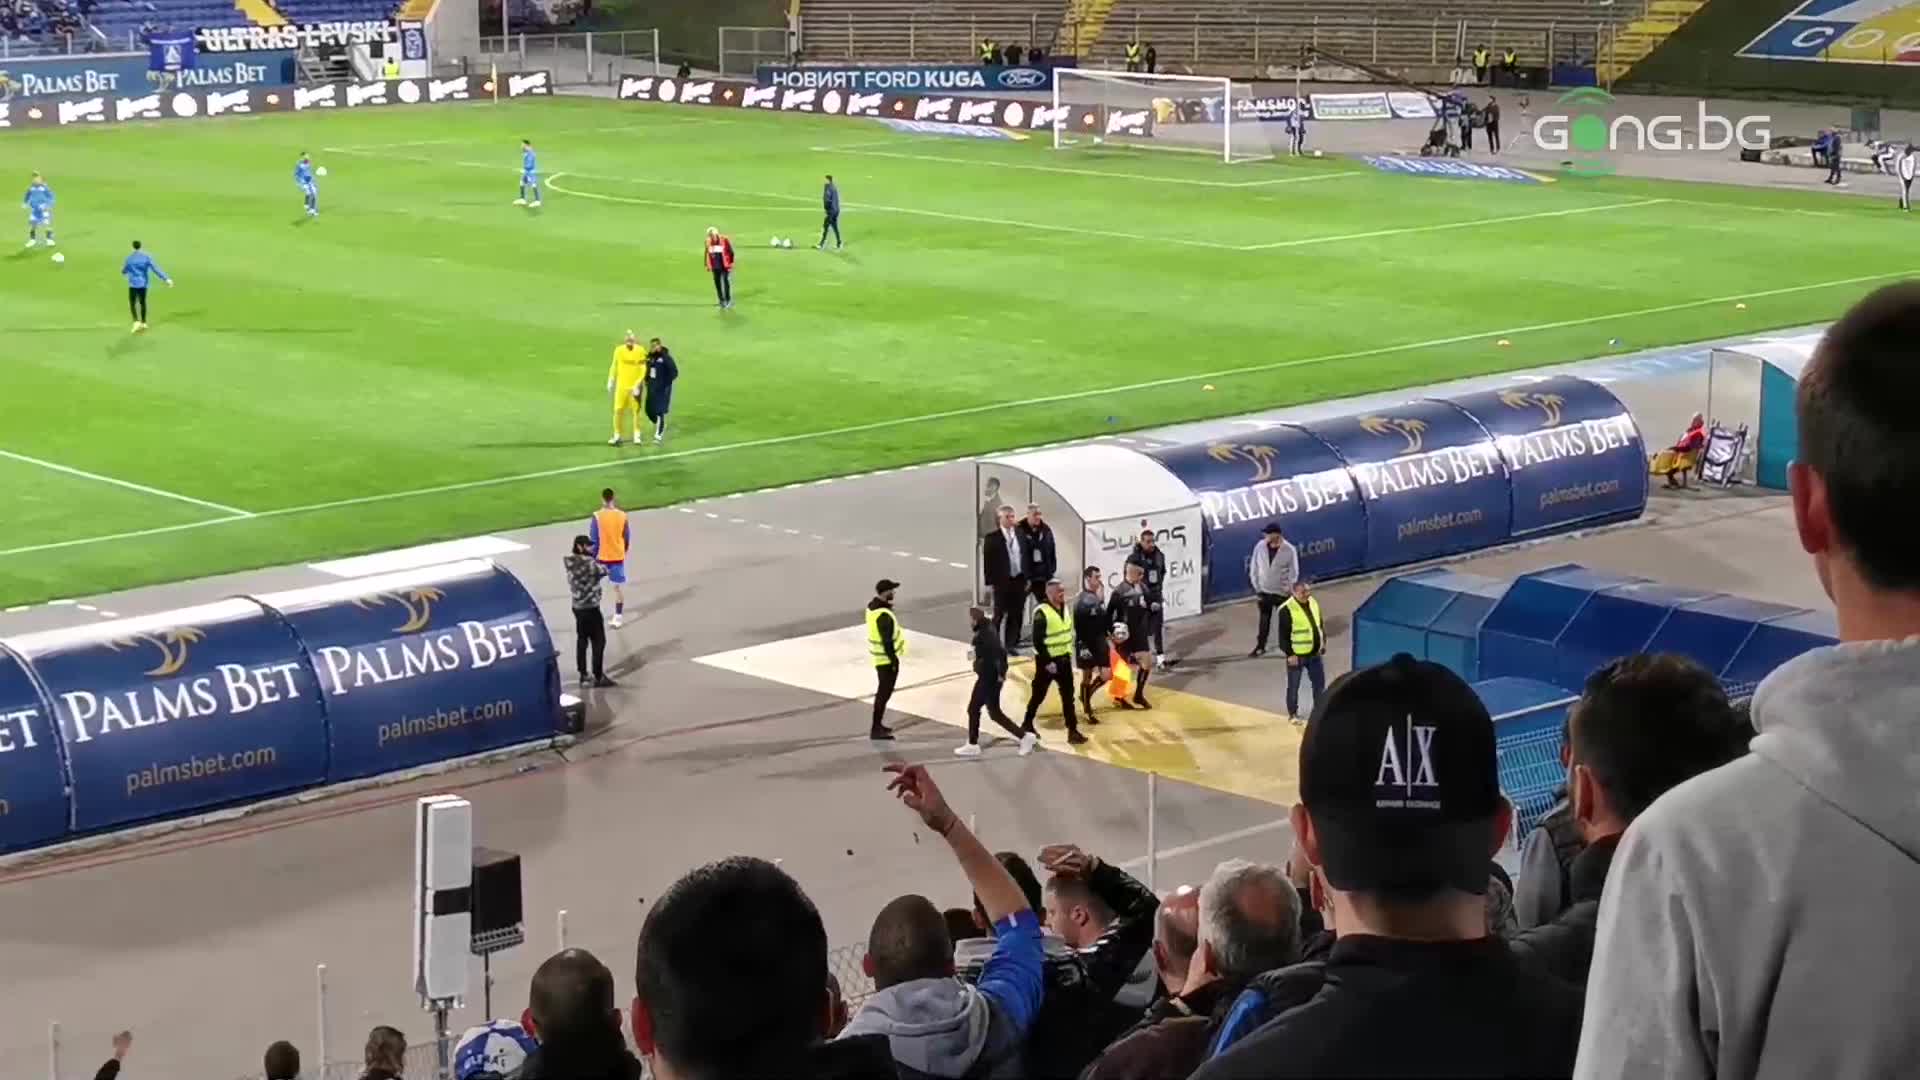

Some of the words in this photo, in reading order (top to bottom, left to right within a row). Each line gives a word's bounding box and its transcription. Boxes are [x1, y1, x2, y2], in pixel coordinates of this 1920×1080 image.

[203, 26, 298, 50] ULTRAS
[304, 21, 390, 46] LEVSKI
[22, 73, 82, 97] PALMS
[84, 70, 119, 93] BET
[176, 68, 233, 88] PALMS
[234, 62, 268, 85] BET
[773, 71, 863, 88] НОВИЯТ
[865, 71, 920, 88] FORD
[925, 71, 985, 88] KUGA
[1498, 429, 1586, 471] PALMS
[1582, 418, 1630, 456] BET
[1357, 455, 1448, 500] PALMS
[1447, 447, 1495, 484] BET
[1201, 485, 1299, 530] PALMS
[1294, 476, 1349, 513] BET
[1398, 509, 1482, 542] palmsbet.com
[318, 634, 460, 696] PALMS
[458, 620, 537, 669] BET
[60, 678, 217, 743] PALMS
[216, 663, 301, 715] BET
[378, 698, 513, 747] palmsbet.com
[0, 708, 39, 751] ET
[126, 746, 277, 796] palmsbet.com
